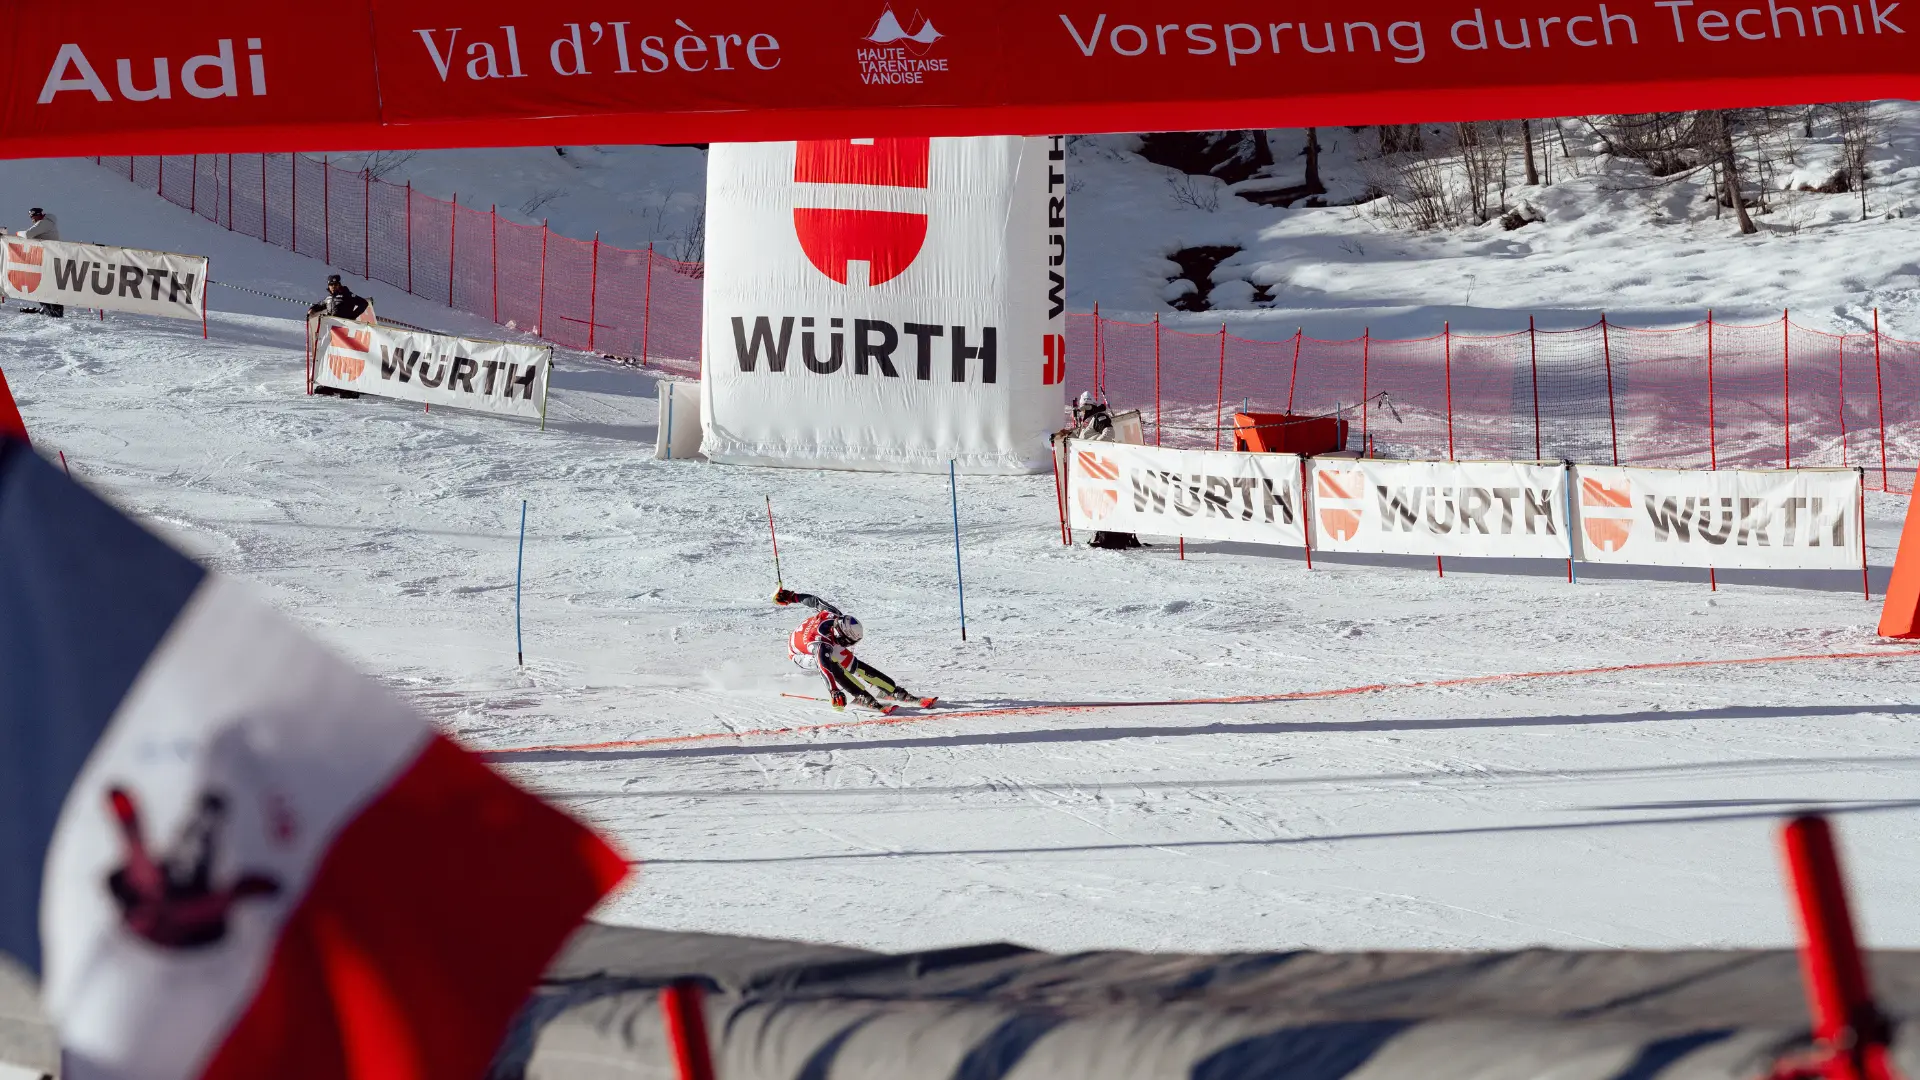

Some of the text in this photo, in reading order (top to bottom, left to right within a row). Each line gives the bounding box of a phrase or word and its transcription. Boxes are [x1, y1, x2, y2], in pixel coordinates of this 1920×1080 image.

[412, 26, 529, 83] Val
[857, 47, 906, 61] HAUTE
[1059, 0, 1906, 67] Vorsprung durch Technik
[36, 37, 268, 105] Audi
[859, 59, 949, 73] TARENTAISE
[861, 71, 924, 85] VANOISE
[53, 257, 195, 305] WÜRTH
[380, 345, 537, 400] WÜRTH
[731, 316, 998, 384] WÜRTH
[1131, 469, 1294, 525] WÜRTH
[1376, 485, 1557, 536] WÜRTH
